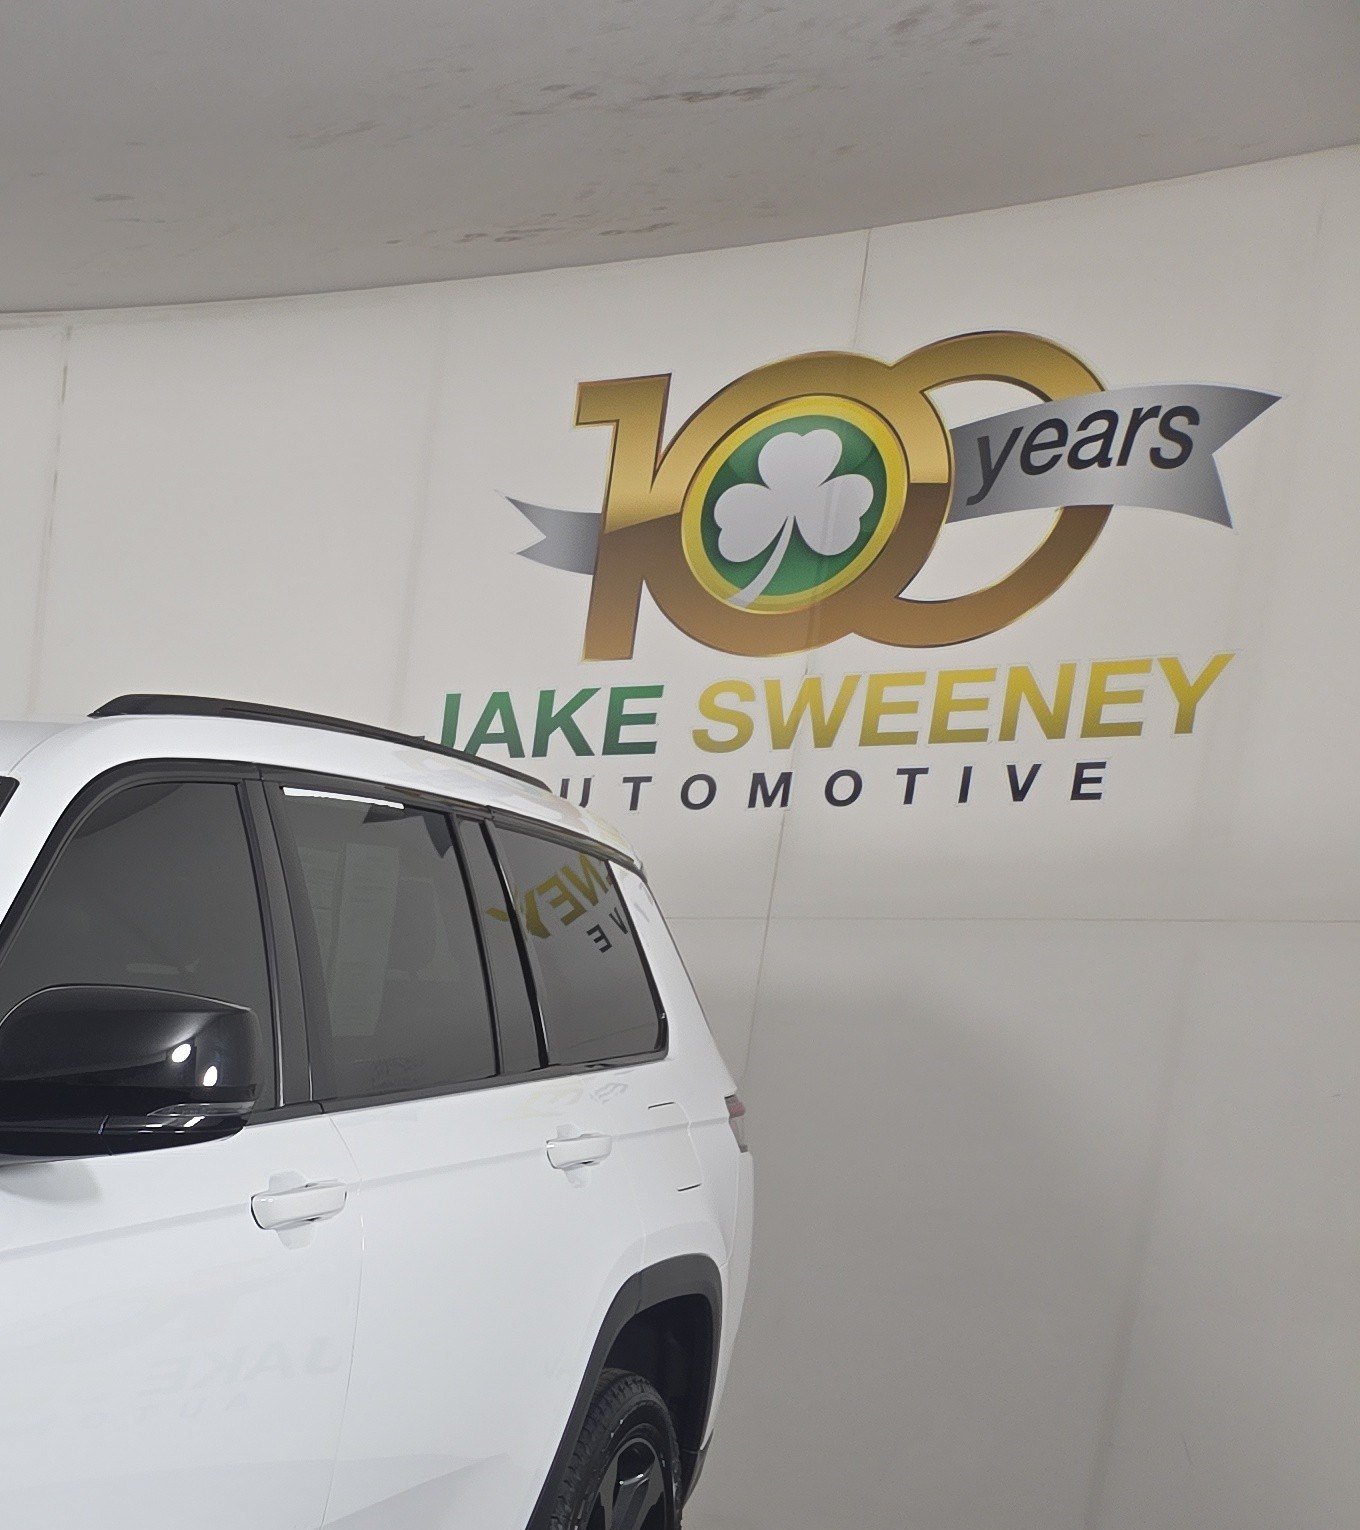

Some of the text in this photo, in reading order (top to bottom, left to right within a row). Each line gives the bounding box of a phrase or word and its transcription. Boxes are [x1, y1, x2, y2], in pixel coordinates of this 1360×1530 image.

[574, 329, 1201, 662] 100 years
[691, 652, 1236, 756] SWEENEY
[560, 760, 1108, 812] UTOMOTIVE
